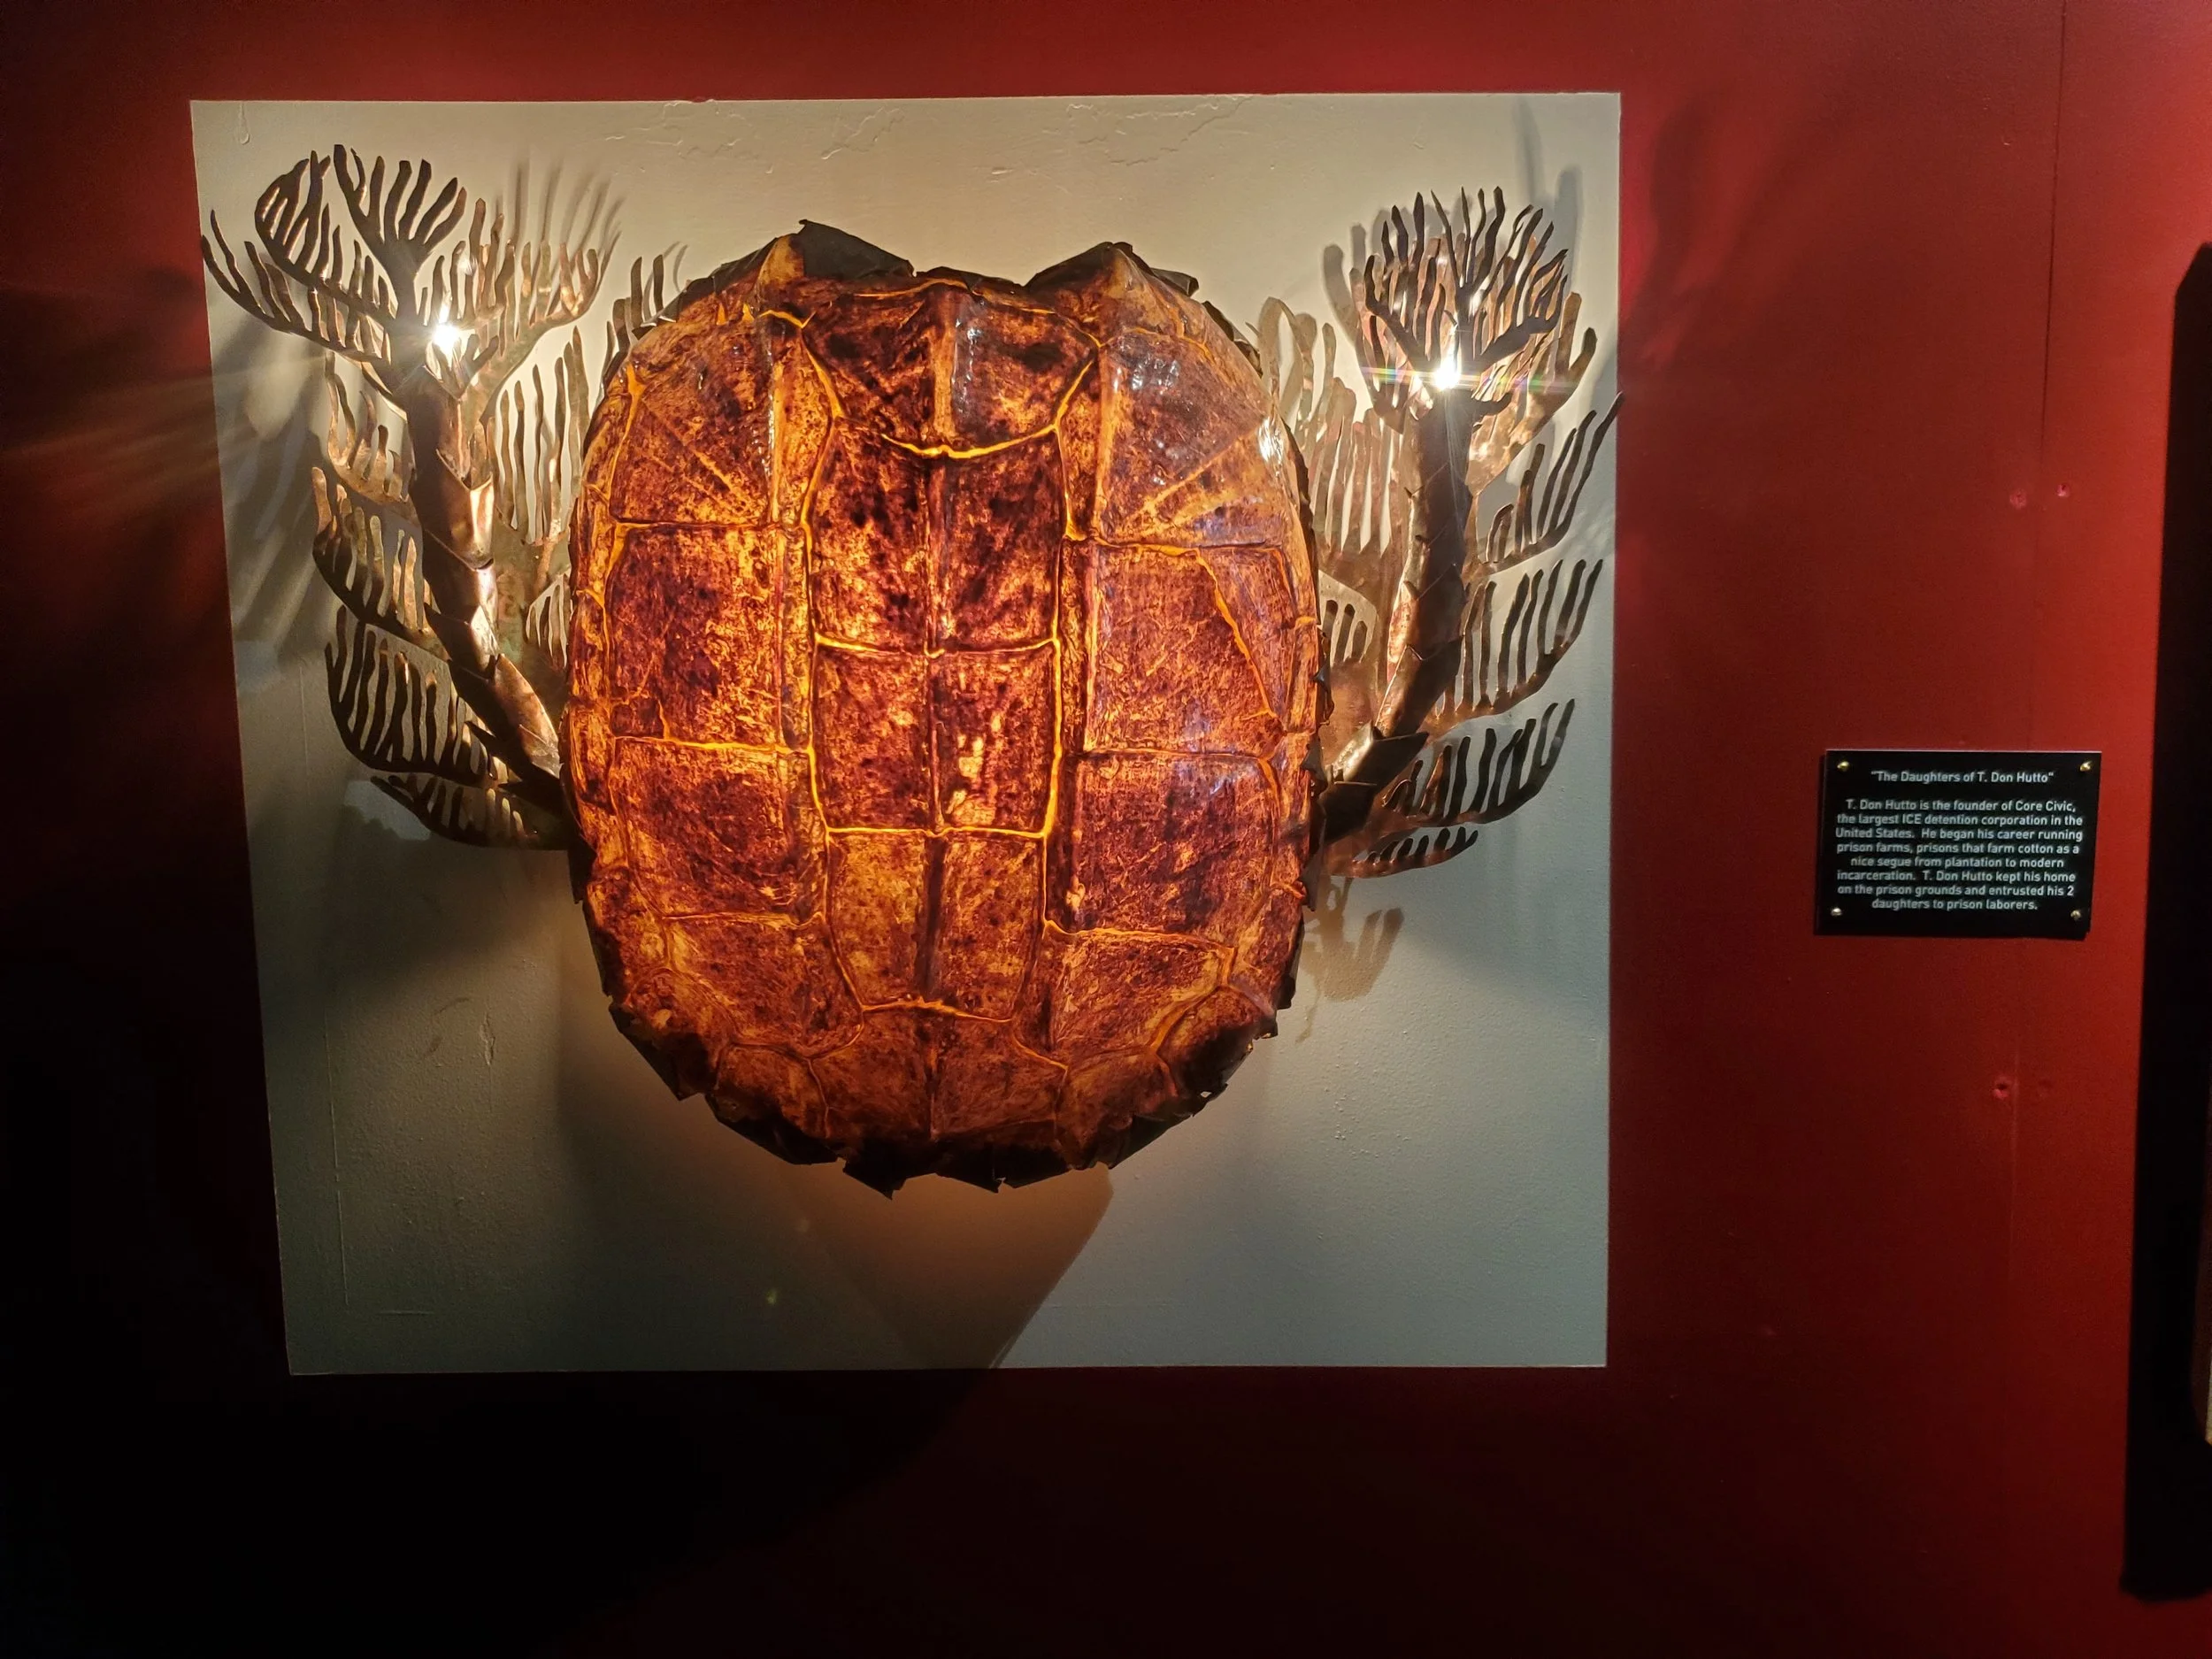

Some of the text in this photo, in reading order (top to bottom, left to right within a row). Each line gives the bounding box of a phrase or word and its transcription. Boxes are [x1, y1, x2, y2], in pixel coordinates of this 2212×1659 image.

[1901, 772, 1960, 784] Daughters
[1963, 772, 1975, 782] of
[1977, 772, 1988, 782] T.
[1991, 772, 2013, 783] Don
[1846, 799, 2076, 813] T. Don Hutto is the founder of Core Civic,
[1837, 814, 2083, 827] the largest ICE detention corporation in the
[1835, 827, 2083, 842] United States. He began his career running
[1837, 842, 1873, 854] prison
[1876, 842, 1913, 854] farms,
[1916, 843, 1959, 855] prisons
[1962, 842, 1985, 853] that
[1987, 843, 2014, 854] farm
[2017, 844, 2053, 854] cotton
[1850, 856, 2064, 869] nice segue from plantation to modern
[1837, 870, 2076, 884] incarceration. T. Don Hutto kept his home
[1837, 884, 2074, 897] on the prison grounds and entrusted his 2
[1871, 898, 2038, 911] daughters to prison laborers.
